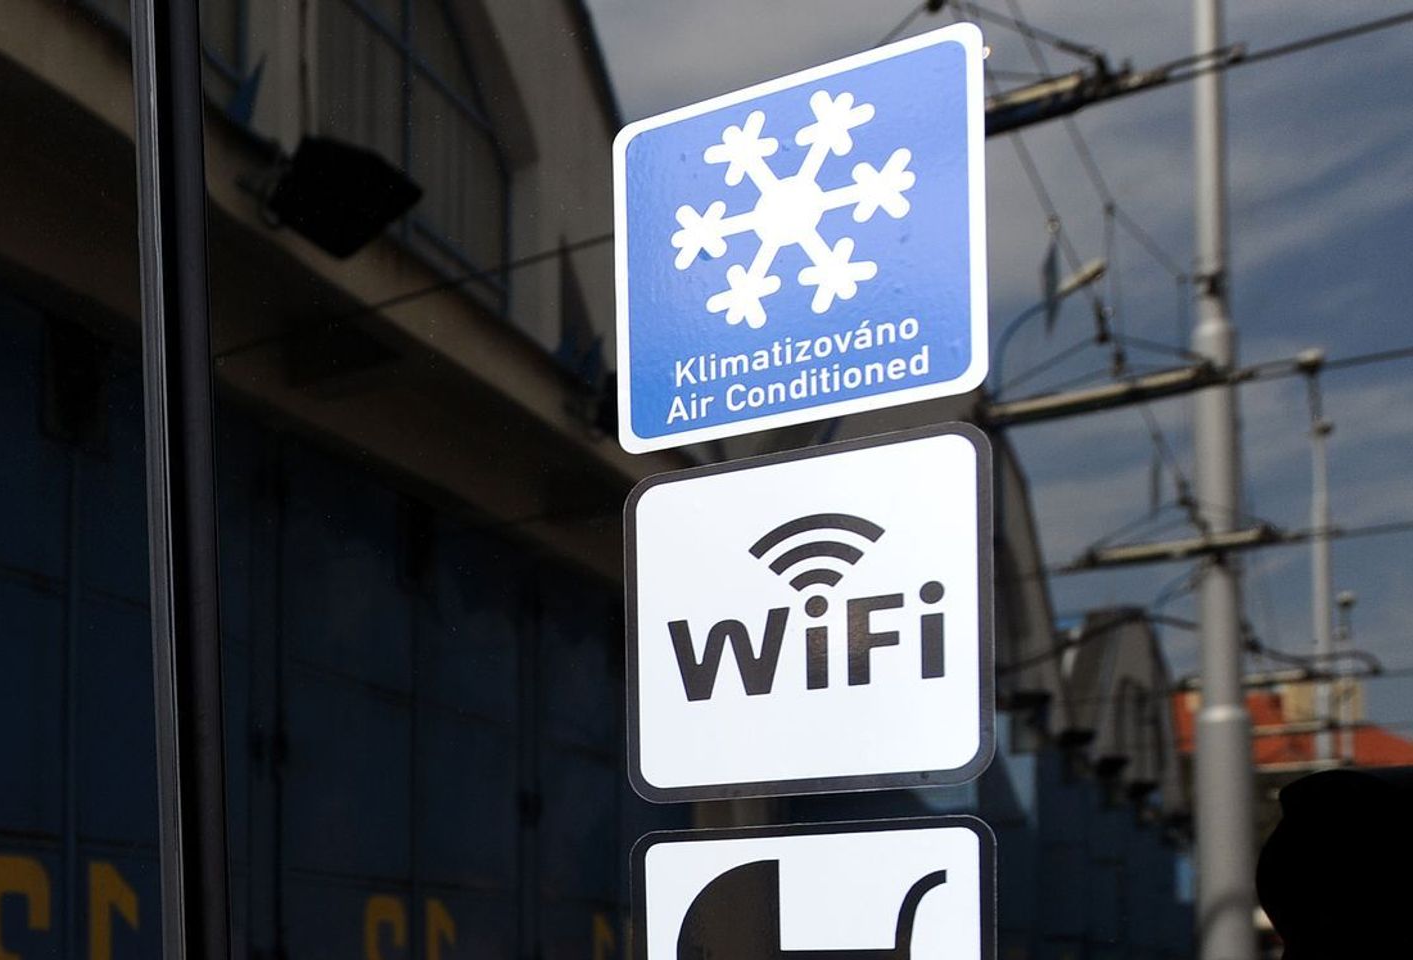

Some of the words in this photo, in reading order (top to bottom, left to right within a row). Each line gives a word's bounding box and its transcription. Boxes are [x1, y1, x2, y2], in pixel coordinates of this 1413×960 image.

[667, 394, 715, 425] Air
[725, 345, 930, 411] Conditioned
[674, 317, 920, 388] Klimatizováno
[668, 580, 945, 701] WiFi
